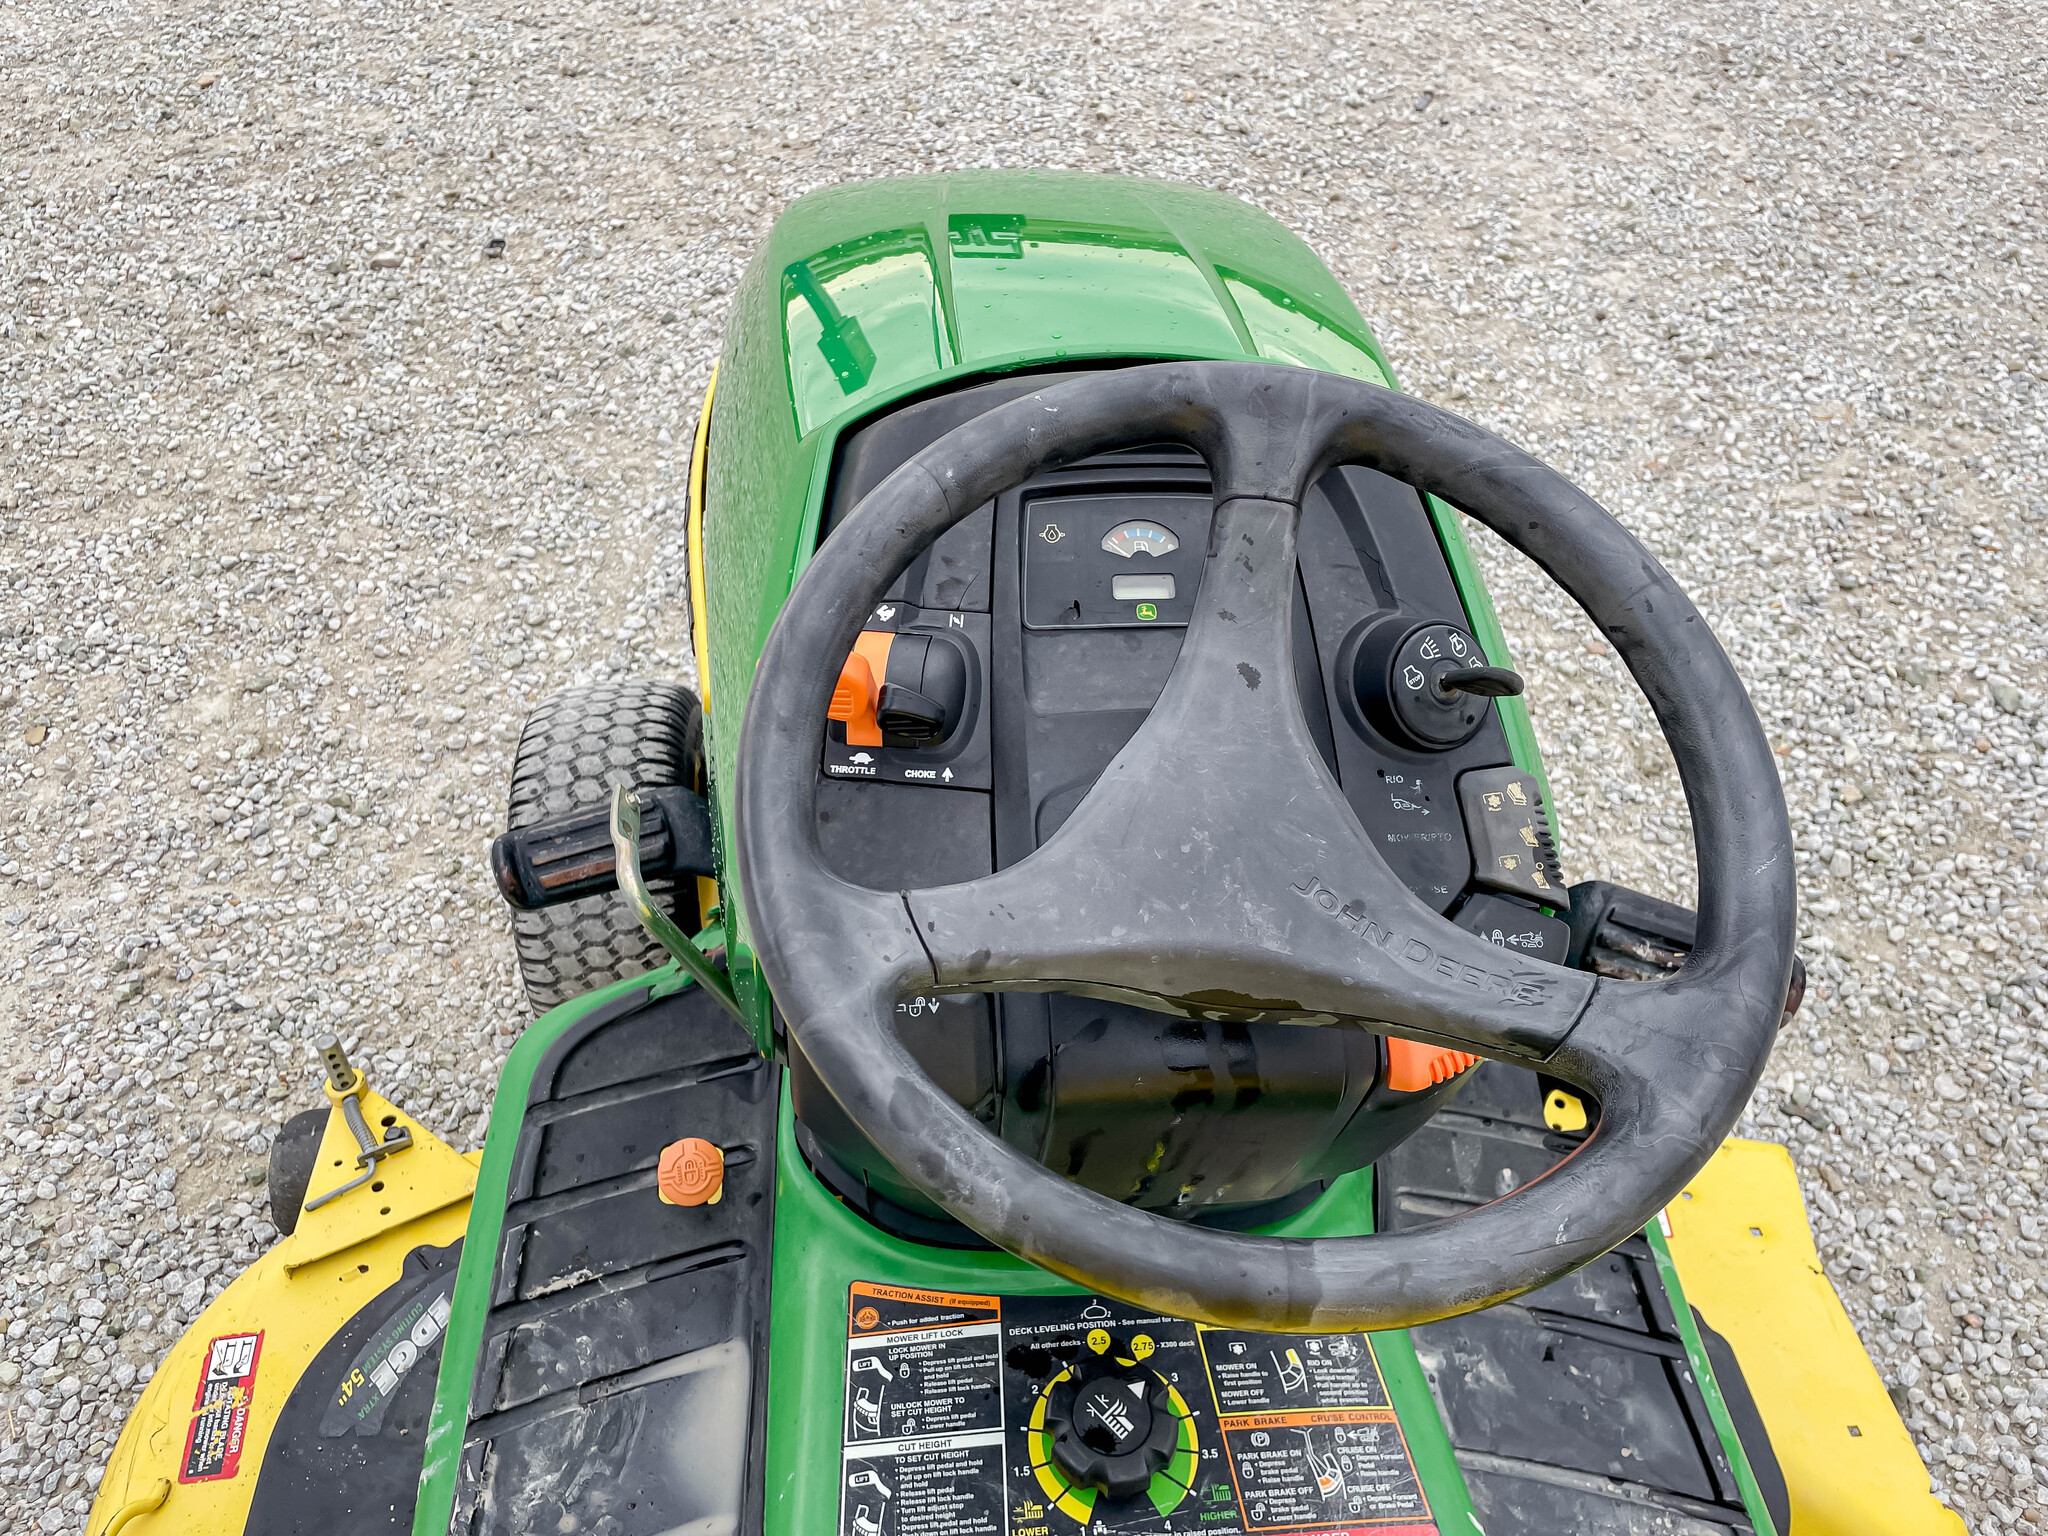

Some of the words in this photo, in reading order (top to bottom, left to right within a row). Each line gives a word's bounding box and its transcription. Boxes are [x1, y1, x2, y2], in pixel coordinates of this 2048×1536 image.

[1409, 674, 1420, 685] STOP
[830, 765, 876, 775] THROTTLE
[905, 770, 936, 778] CHOKE
[1386, 775, 1403, 783] RIO
[1290, 876, 1392, 949] JOHN
[1402, 938, 1545, 1006] DEERE
[873, 1288, 913, 1300] TRACTION
[915, 1294, 944, 1304] ASSIST
[392, 1302, 423, 1340] CUTTING
[1009, 1327, 1032, 1336] DECK
[1035, 1323, 1075, 1334] LEVELING
[1077, 1320, 1116, 1332] POSITION
[1137, 1317, 1161, 1325] manual
[887, 1334, 918, 1344] MOWER
[921, 1332, 939, 1340] LIFT
[941, 1329, 964, 1337] LOCK
[1092, 1337, 1107, 1345] 2.5
[369, 1292, 451, 1397] EDGE
[1061, 1339, 1081, 1347] decks
[1133, 1342, 1154, 1351] 2.75
[910, 1344, 938, 1352] MOWER
[362, 1337, 393, 1373] SYSTEM
[900, 1351, 934, 1359] POSITION
[1172, 1373, 1178, 1382] 3
[339, 1368, 365, 1406] 54"
[1032, 1385, 1039, 1394] 2
[358, 1393, 380, 1420] XTRA
[891, 1401, 923, 1410] UNLOCK
[924, 1398, 953, 1407] MOWER
[891, 1410, 906, 1418] SET
[924, 1405, 952, 1414] HEIGHT
[960, 1412, 976, 1420] pedal
[1224, 1419, 1249, 1427] PARK
[1254, 1417, 1287, 1425] BRAKE
[1311, 1414, 1344, 1422] CRUISE
[229, 1408, 245, 1453] DANGER
[898, 1442, 916, 1451] CUT
[919, 1439, 952, 1449] HEIGHT
[1202, 1449, 1218, 1458] 3.5
[1337, 1446, 1364, 1454] CRUISE
[924, 1453, 939, 1461] CUT
[941, 1450, 969, 1459] HEIGHT
[1237, 1452, 1259, 1460] PARK
[1260, 1450, 1288, 1459] BRAKE
[1013, 1466, 1030, 1477] 1.5
[855, 1475, 869, 1483] LIFT
[937, 1486, 954, 1495] pedal
[1245, 1490, 1267, 1498] PARK
[1268, 1488, 1296, 1497] BRAKE
[1298, 1486, 1314, 1494] OFF
[927, 1504, 947, 1512] adjust
[935, 1511, 955, 1520] height
[1200, 1511, 1238, 1520] HIGHER
[902, 1523, 928, 1531] Depress
[975, 1524, 997, 1532] handle
[1164, 1520, 1172, 1530] 4
[1012, 1527, 1048, 1536] LOWER
[1080, 1527, 1085, 1536] 1
[1183, 1528, 1206, 1536] raised
[1207, 1527, 1240, 1535] position.
